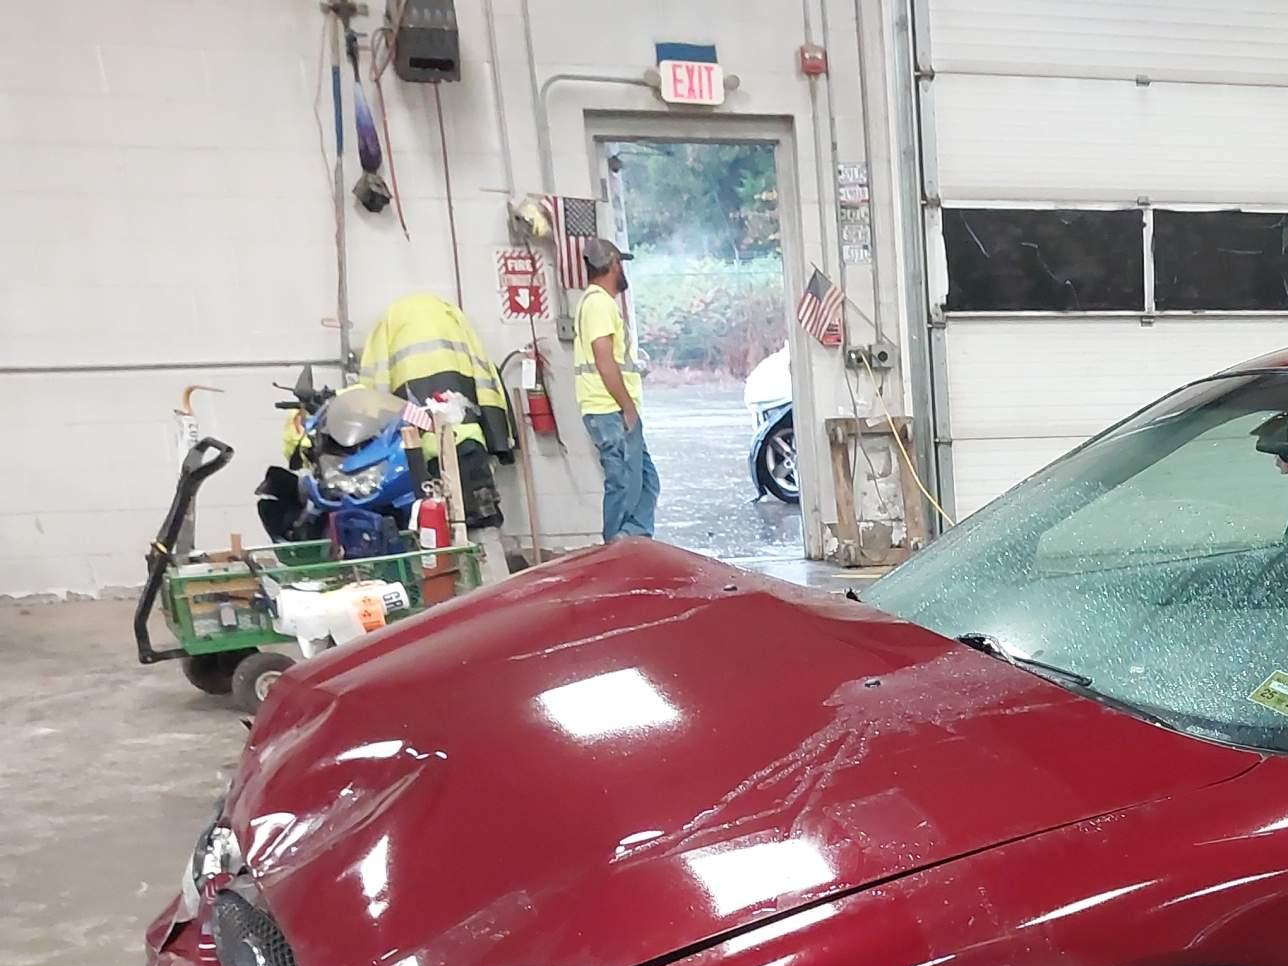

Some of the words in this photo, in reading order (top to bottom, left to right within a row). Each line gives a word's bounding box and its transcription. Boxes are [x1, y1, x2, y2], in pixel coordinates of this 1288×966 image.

[671, 63, 715, 100] EXIT
[506, 258, 534, 272] FIRE
[1260, 688, 1278, 700] 25
